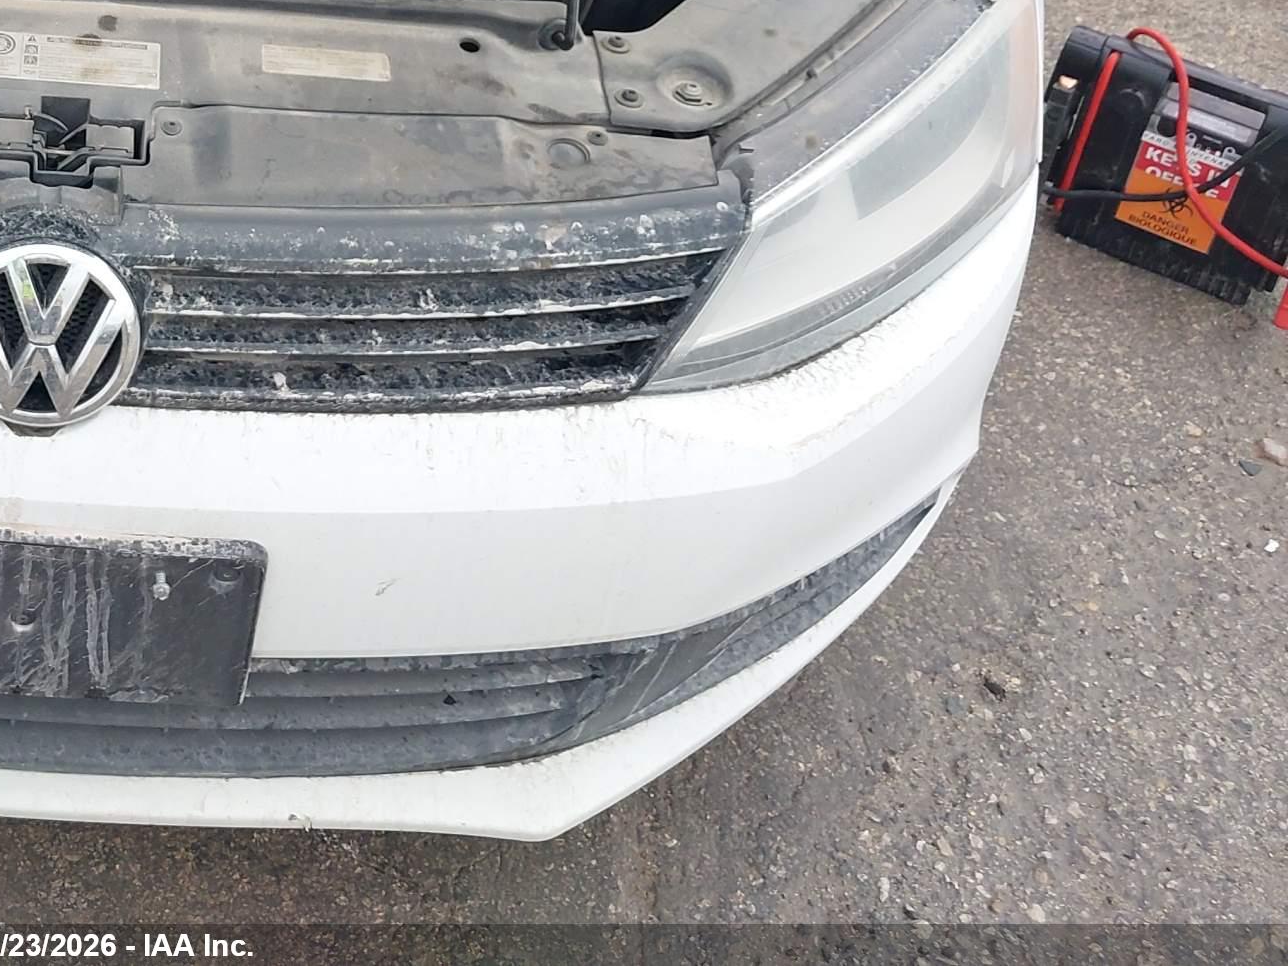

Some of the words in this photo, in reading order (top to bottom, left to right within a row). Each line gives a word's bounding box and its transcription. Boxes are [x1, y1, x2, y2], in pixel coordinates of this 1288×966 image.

[1144, 146, 1203, 177] KES
[1128, 214, 1199, 245] BIOLOGIQUE
[1142, 211, 1189, 234] DANGER
